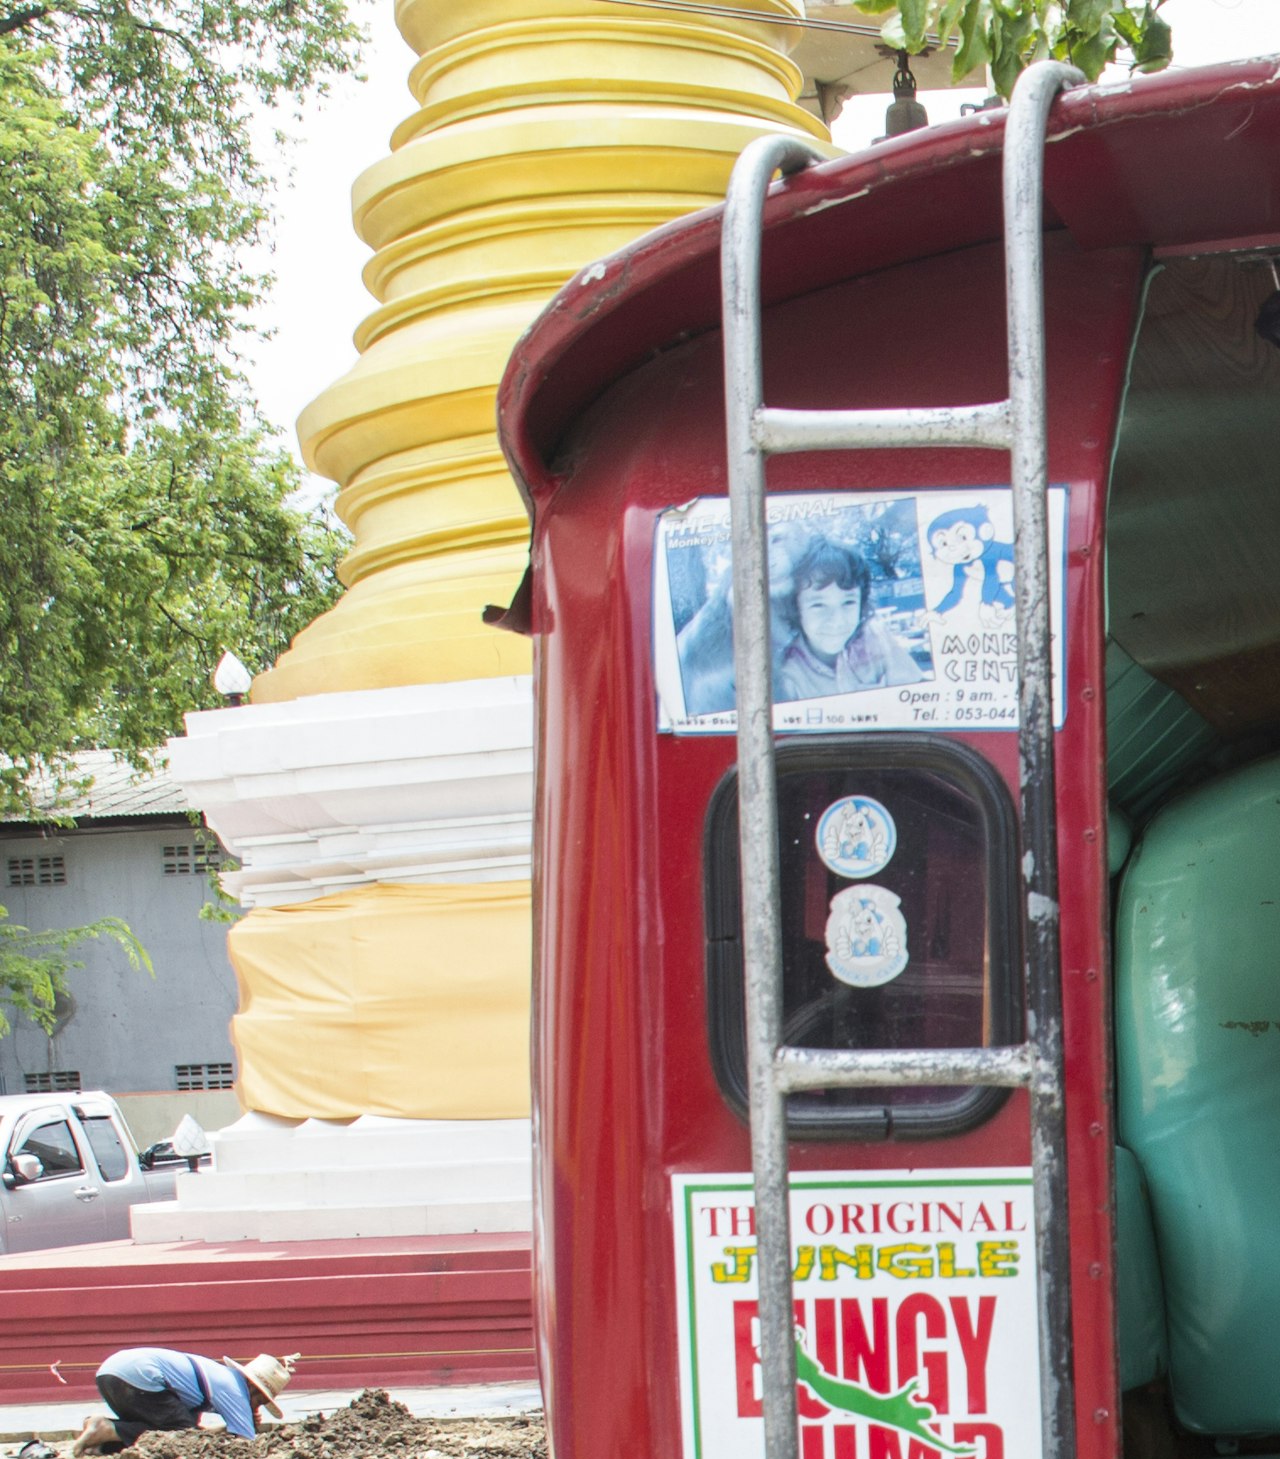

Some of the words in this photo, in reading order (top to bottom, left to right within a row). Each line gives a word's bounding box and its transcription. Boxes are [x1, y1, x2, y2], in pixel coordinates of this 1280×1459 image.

[664, 513, 713, 537] THE
[722, 498, 840, 530] OGINAL
[668, 535, 713, 549] Monkey
[941, 633, 1056, 656] MONK
[944, 659, 1056, 682] CENT
[899, 690, 940, 704] Open
[956, 689, 965, 702] 9
[913, 708, 939, 721] Tel.
[700, 1206, 757, 1237] TH
[805, 1201, 1027, 1237] ORIGINAL
